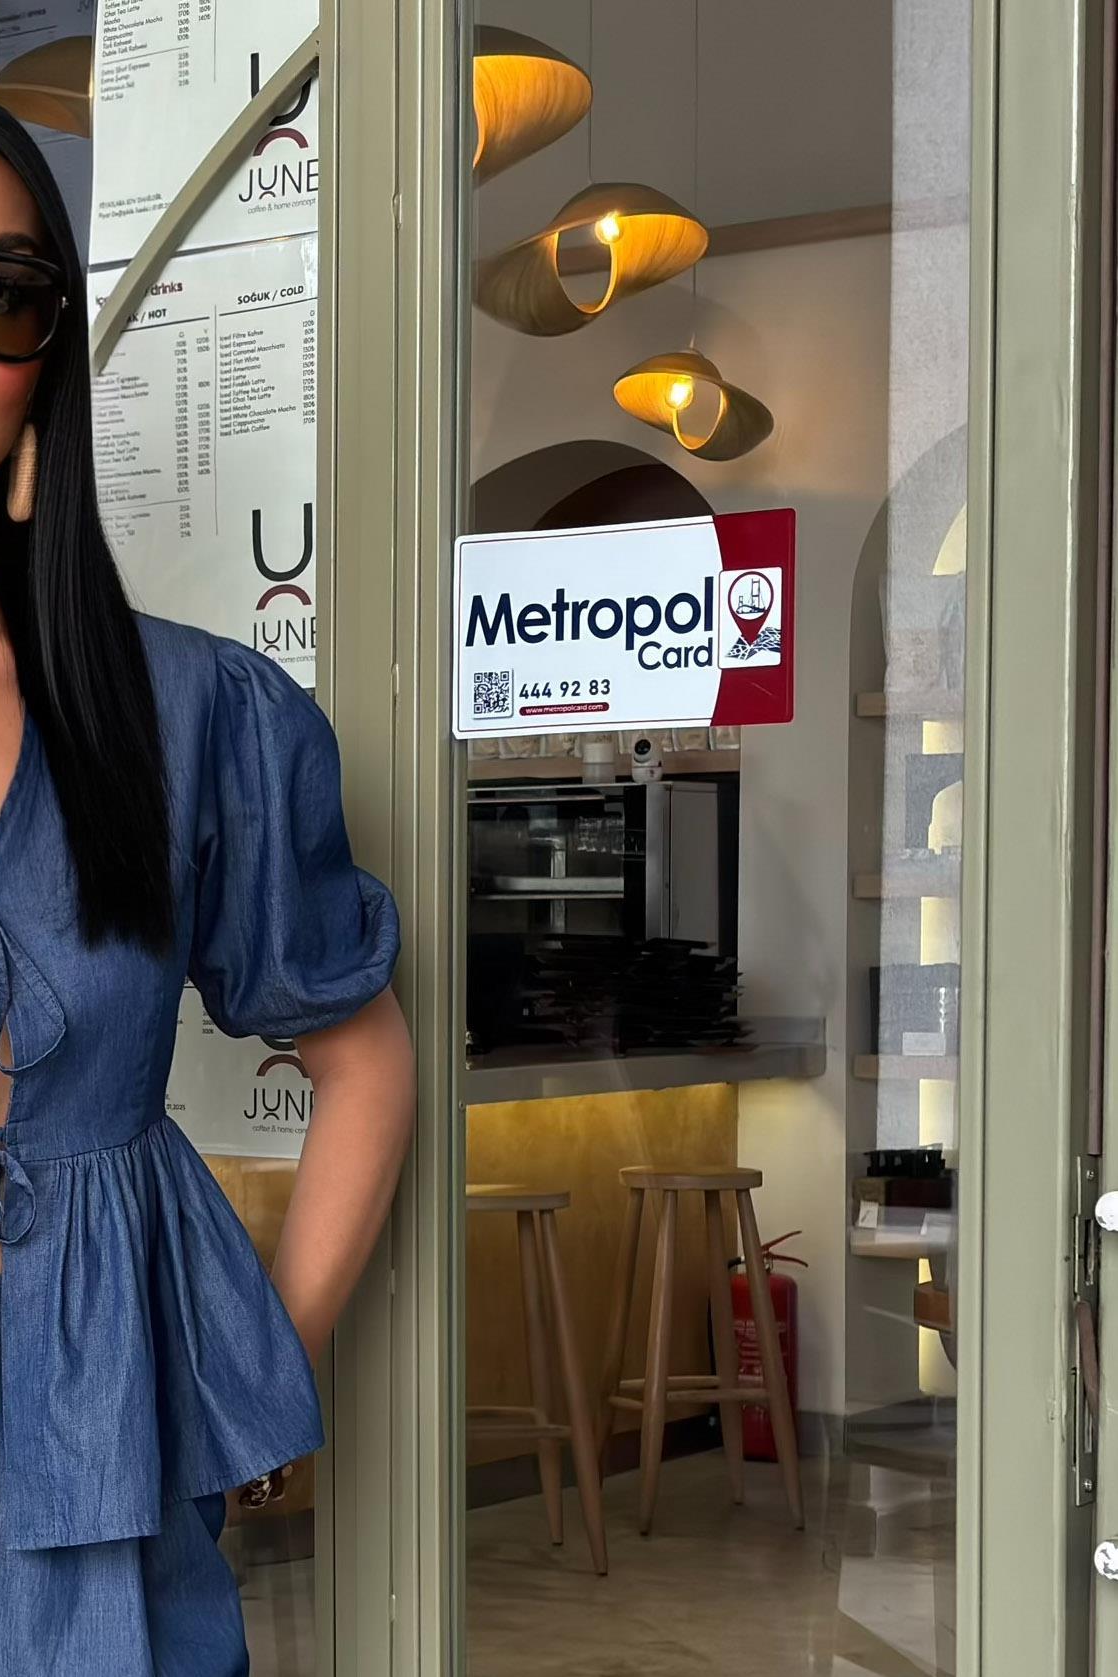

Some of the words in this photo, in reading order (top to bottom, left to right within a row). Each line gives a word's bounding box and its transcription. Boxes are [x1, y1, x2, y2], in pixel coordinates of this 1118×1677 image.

[239, 159, 318, 203] JUNE
[150, 283, 183, 296] drinks
[237, 291, 270, 305] SOĞUK
[280, 285, 304, 298] COLD
[148, 308, 167, 319] HOT
[465, 576, 714, 650] Metropol
[637, 637, 713, 671] Card
[519, 681, 552, 699] 444
[560, 681, 581, 697] 92
[589, 679, 610, 695] 83
[525, 704, 603, 714] www.metropolcard.com
